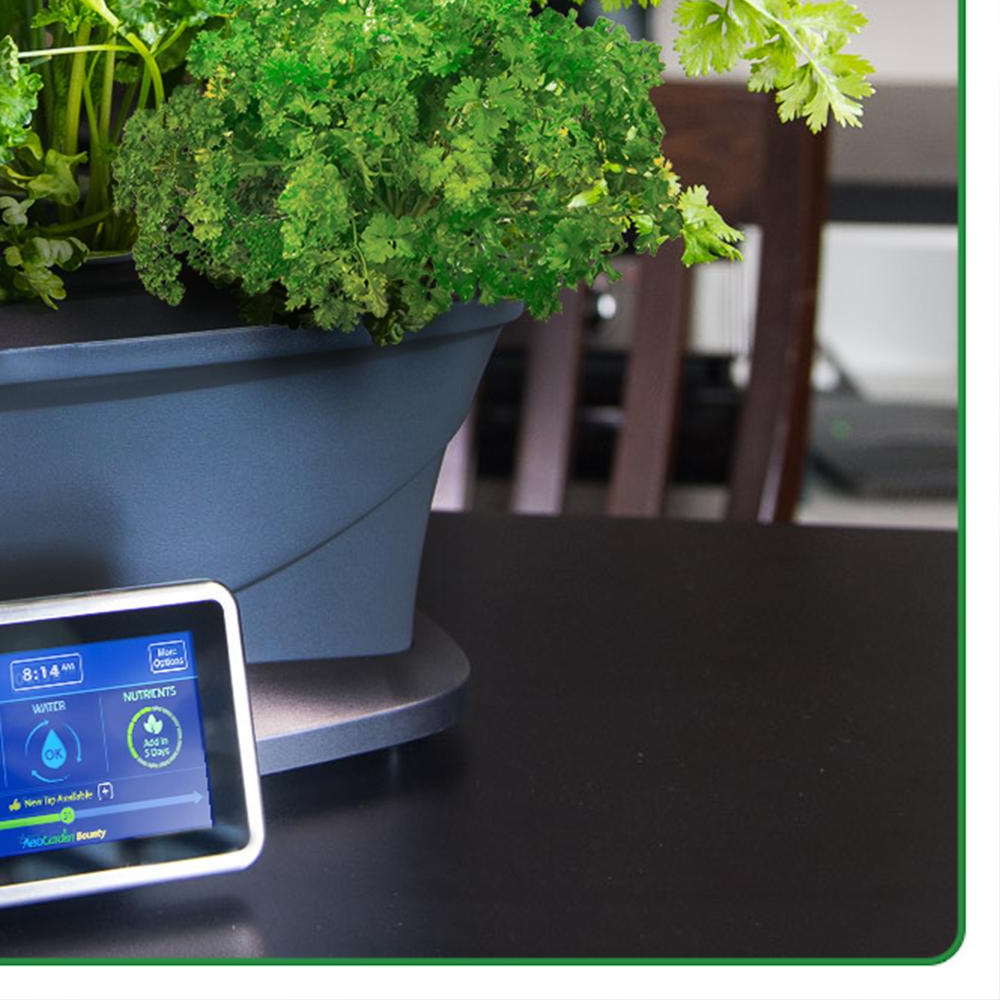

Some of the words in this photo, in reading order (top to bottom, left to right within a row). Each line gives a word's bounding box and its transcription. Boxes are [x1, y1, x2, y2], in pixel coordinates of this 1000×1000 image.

[157, 647, 177, 657] More
[153, 656, 184, 668] Options
[22, 664, 60, 682] 8:14
[122, 685, 177, 702] NUTRIENTS
[32, 700, 67, 714] WATER
[44, 748, 66, 762] OK
[76, 829, 107, 841] Bounty
